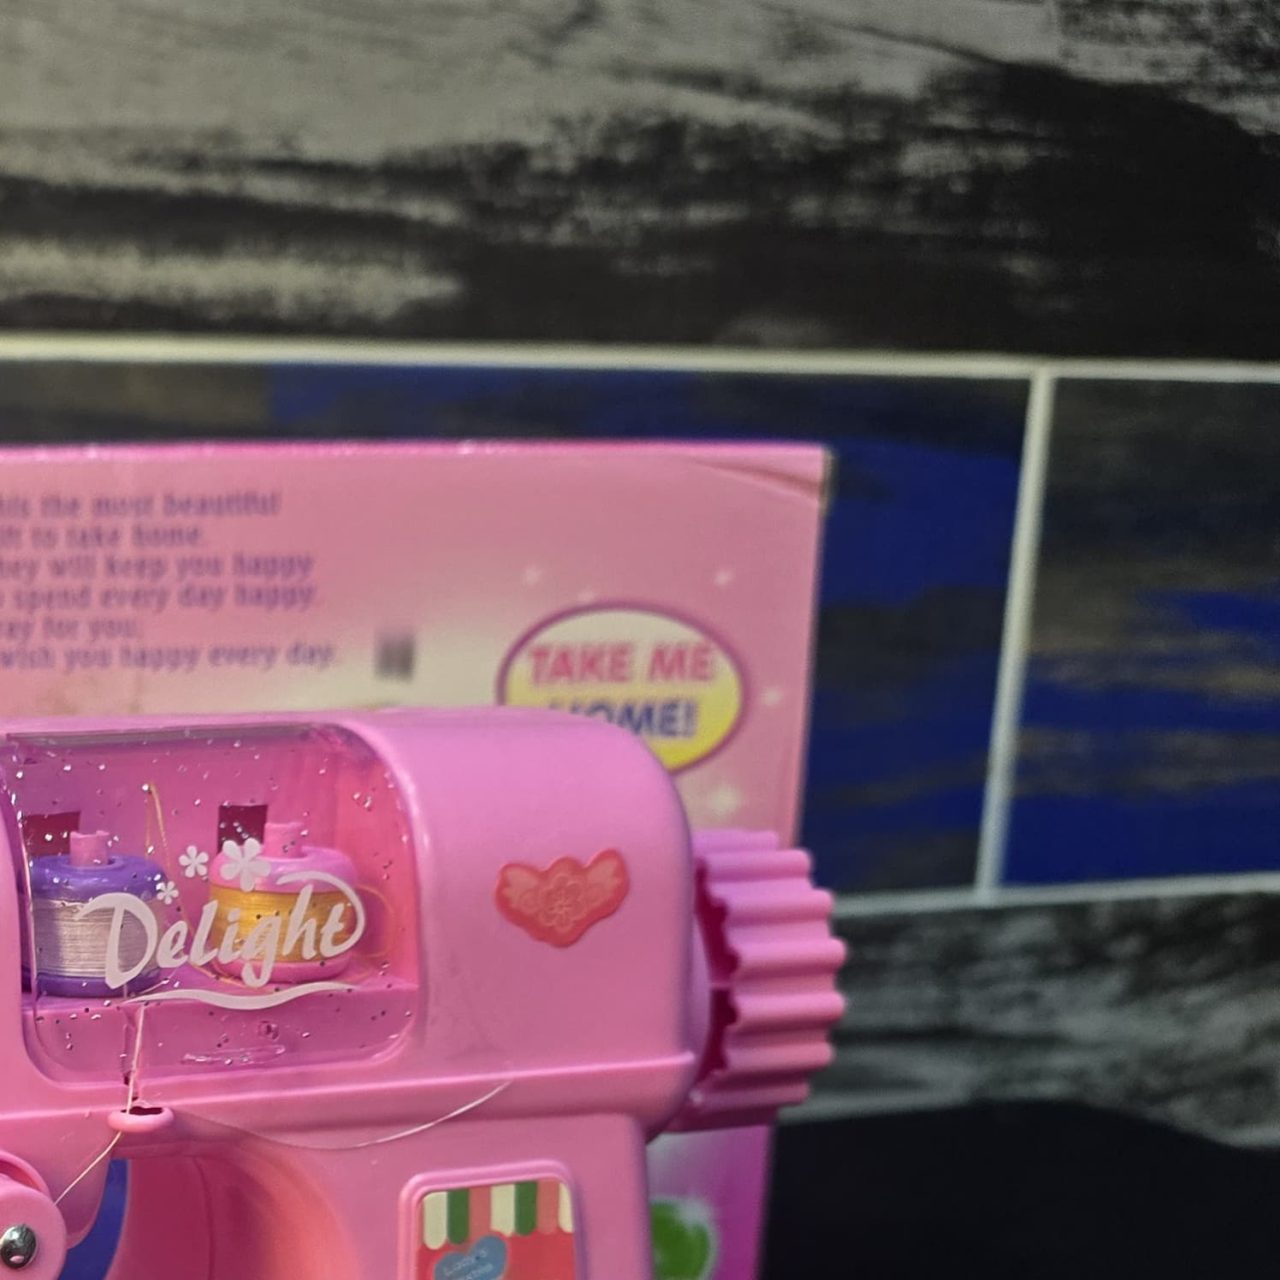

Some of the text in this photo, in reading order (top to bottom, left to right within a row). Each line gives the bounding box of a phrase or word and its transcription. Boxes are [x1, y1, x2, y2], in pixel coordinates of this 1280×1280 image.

[163, 491, 281, 517] beautiful
[529, 643, 713, 684] TAKE ME
[74, 869, 365, 989] Delight
